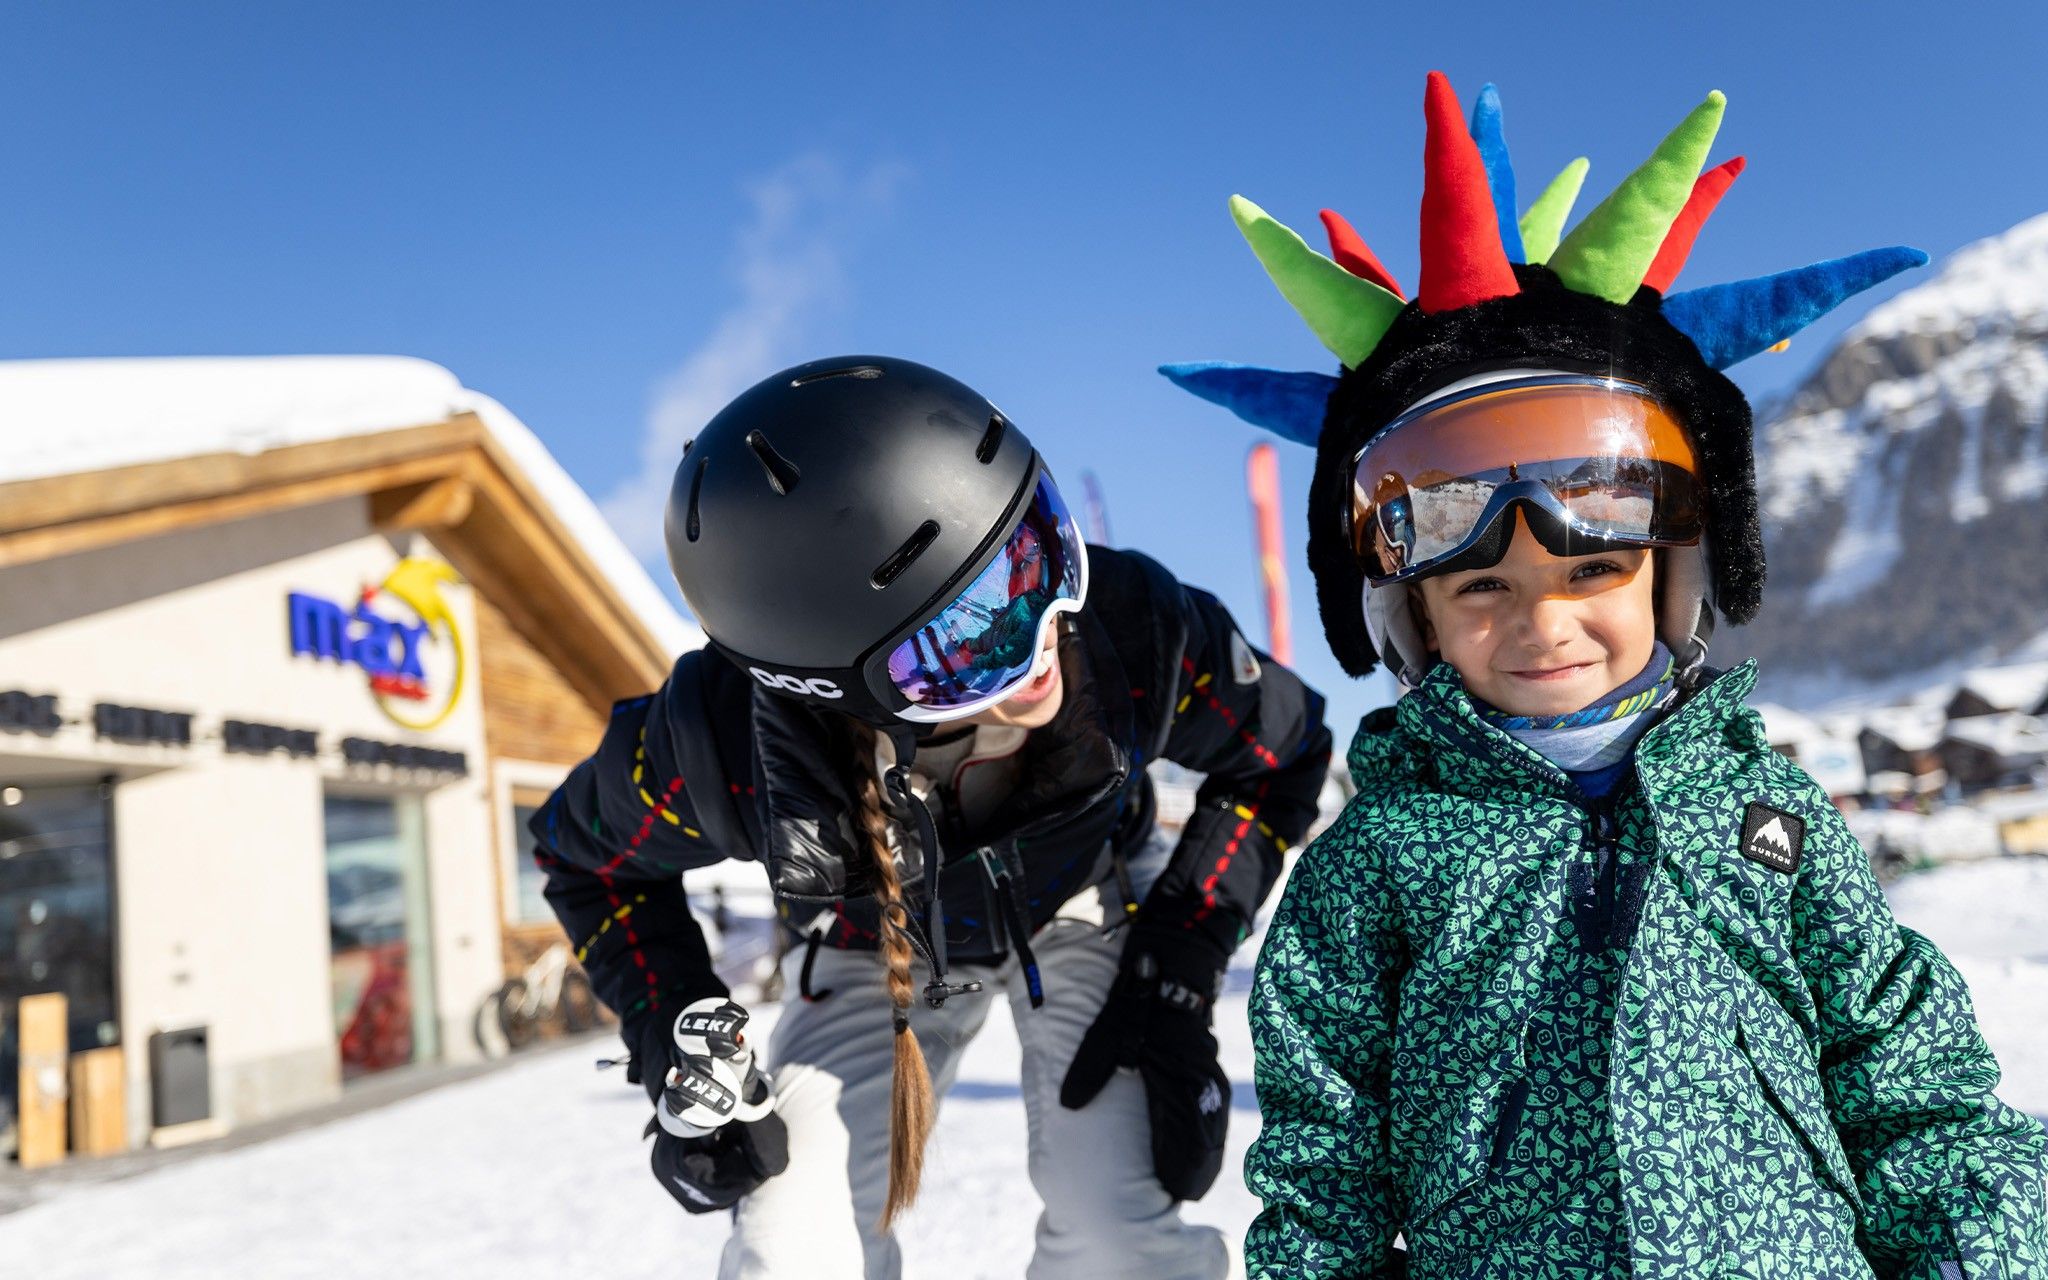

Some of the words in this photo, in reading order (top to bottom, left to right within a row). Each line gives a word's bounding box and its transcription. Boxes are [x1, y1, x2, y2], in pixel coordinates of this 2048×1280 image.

[287, 592, 429, 678] max
[748, 666, 844, 699] POC
[1750, 844, 1791, 866] BURTON
[680, 1017, 734, 1034] LEKI
[682, 1075, 734, 1110] LEKI
